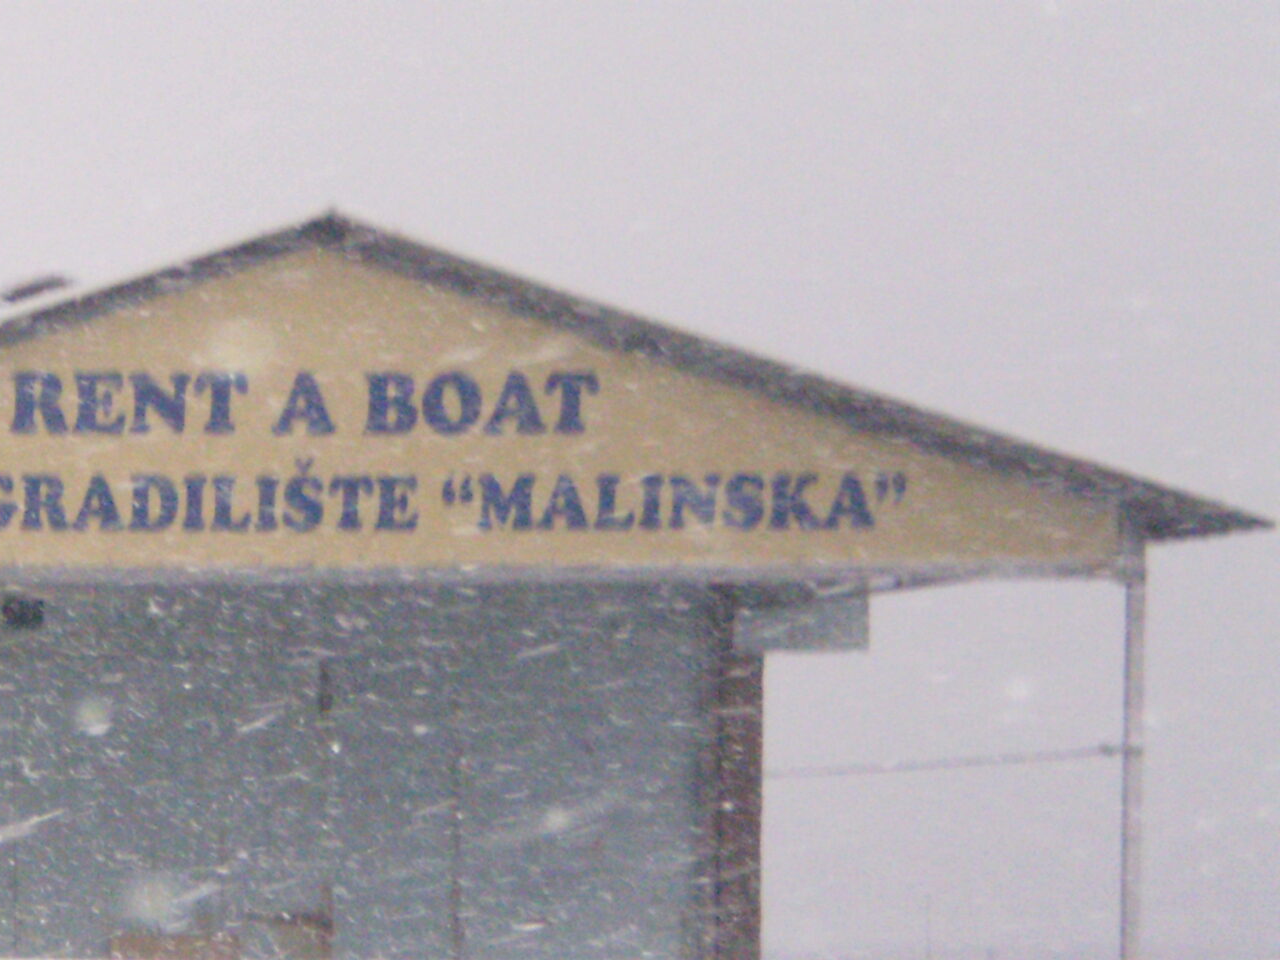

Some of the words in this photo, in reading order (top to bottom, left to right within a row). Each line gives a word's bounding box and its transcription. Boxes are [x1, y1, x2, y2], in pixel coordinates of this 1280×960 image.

[10, 370, 248, 435] RENT
[272, 370, 335, 435] A
[363, 370, 600, 435] BOAT
[441, 471, 907, 533] “MALINSKA”
